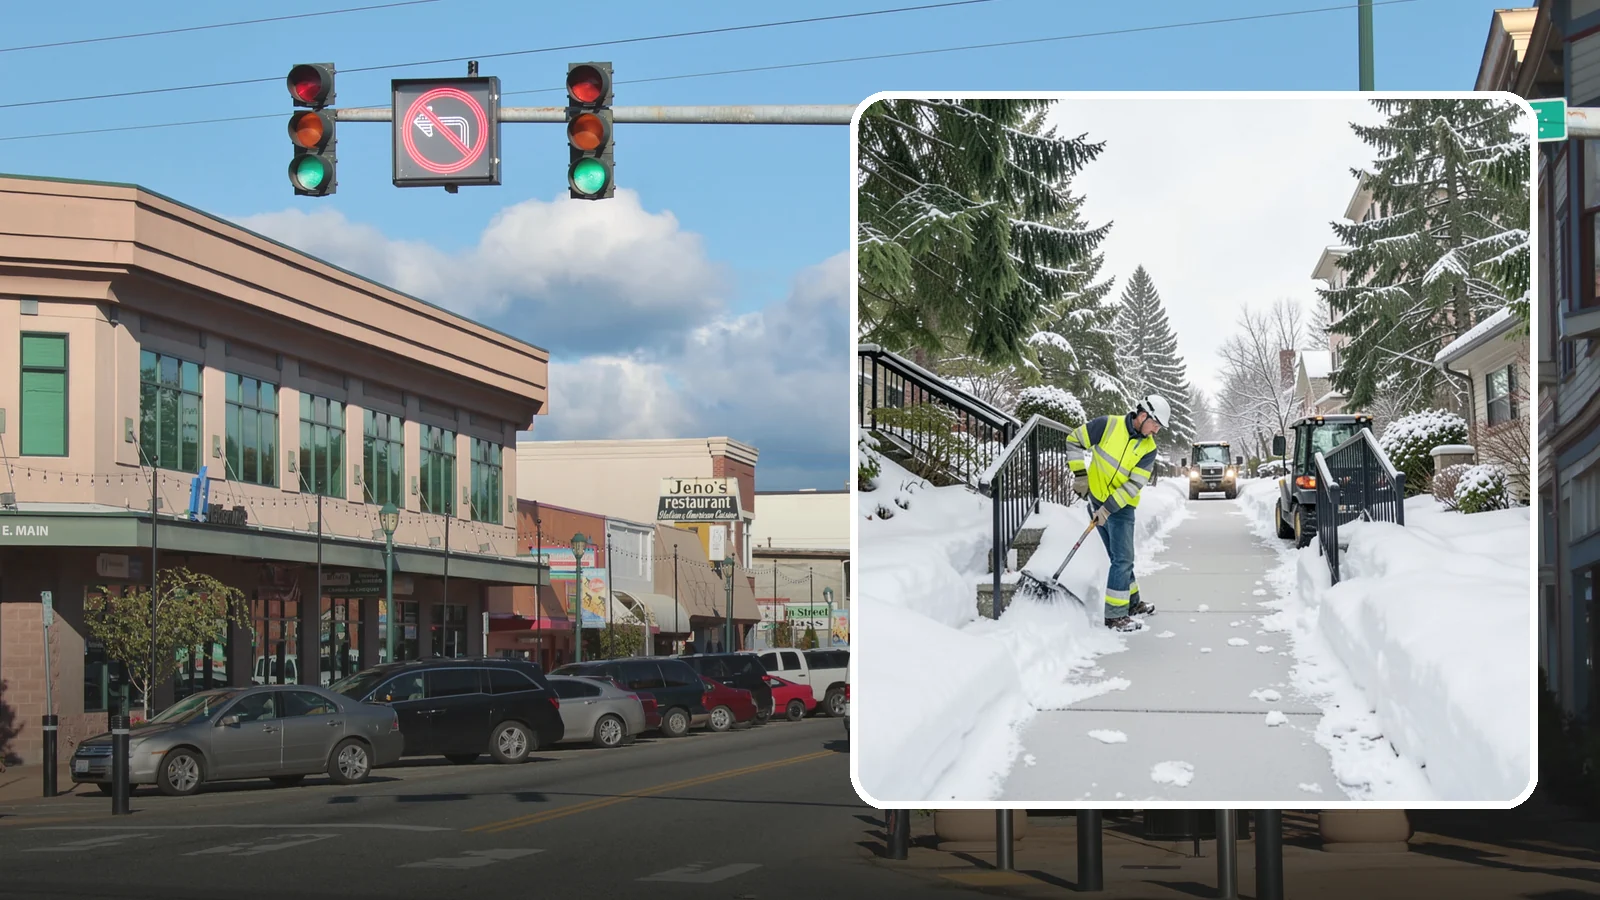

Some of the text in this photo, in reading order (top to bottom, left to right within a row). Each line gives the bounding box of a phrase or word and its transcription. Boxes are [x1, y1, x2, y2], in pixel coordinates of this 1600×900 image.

[670, 480, 727, 494] Jeno's
[664, 496, 731, 509] restaurant
[715, 509, 737, 519] Cuisine
[2, 525, 49, 536] E. MAIN
[797, 607, 828, 616] Street
[790, 619, 824, 627] lass
